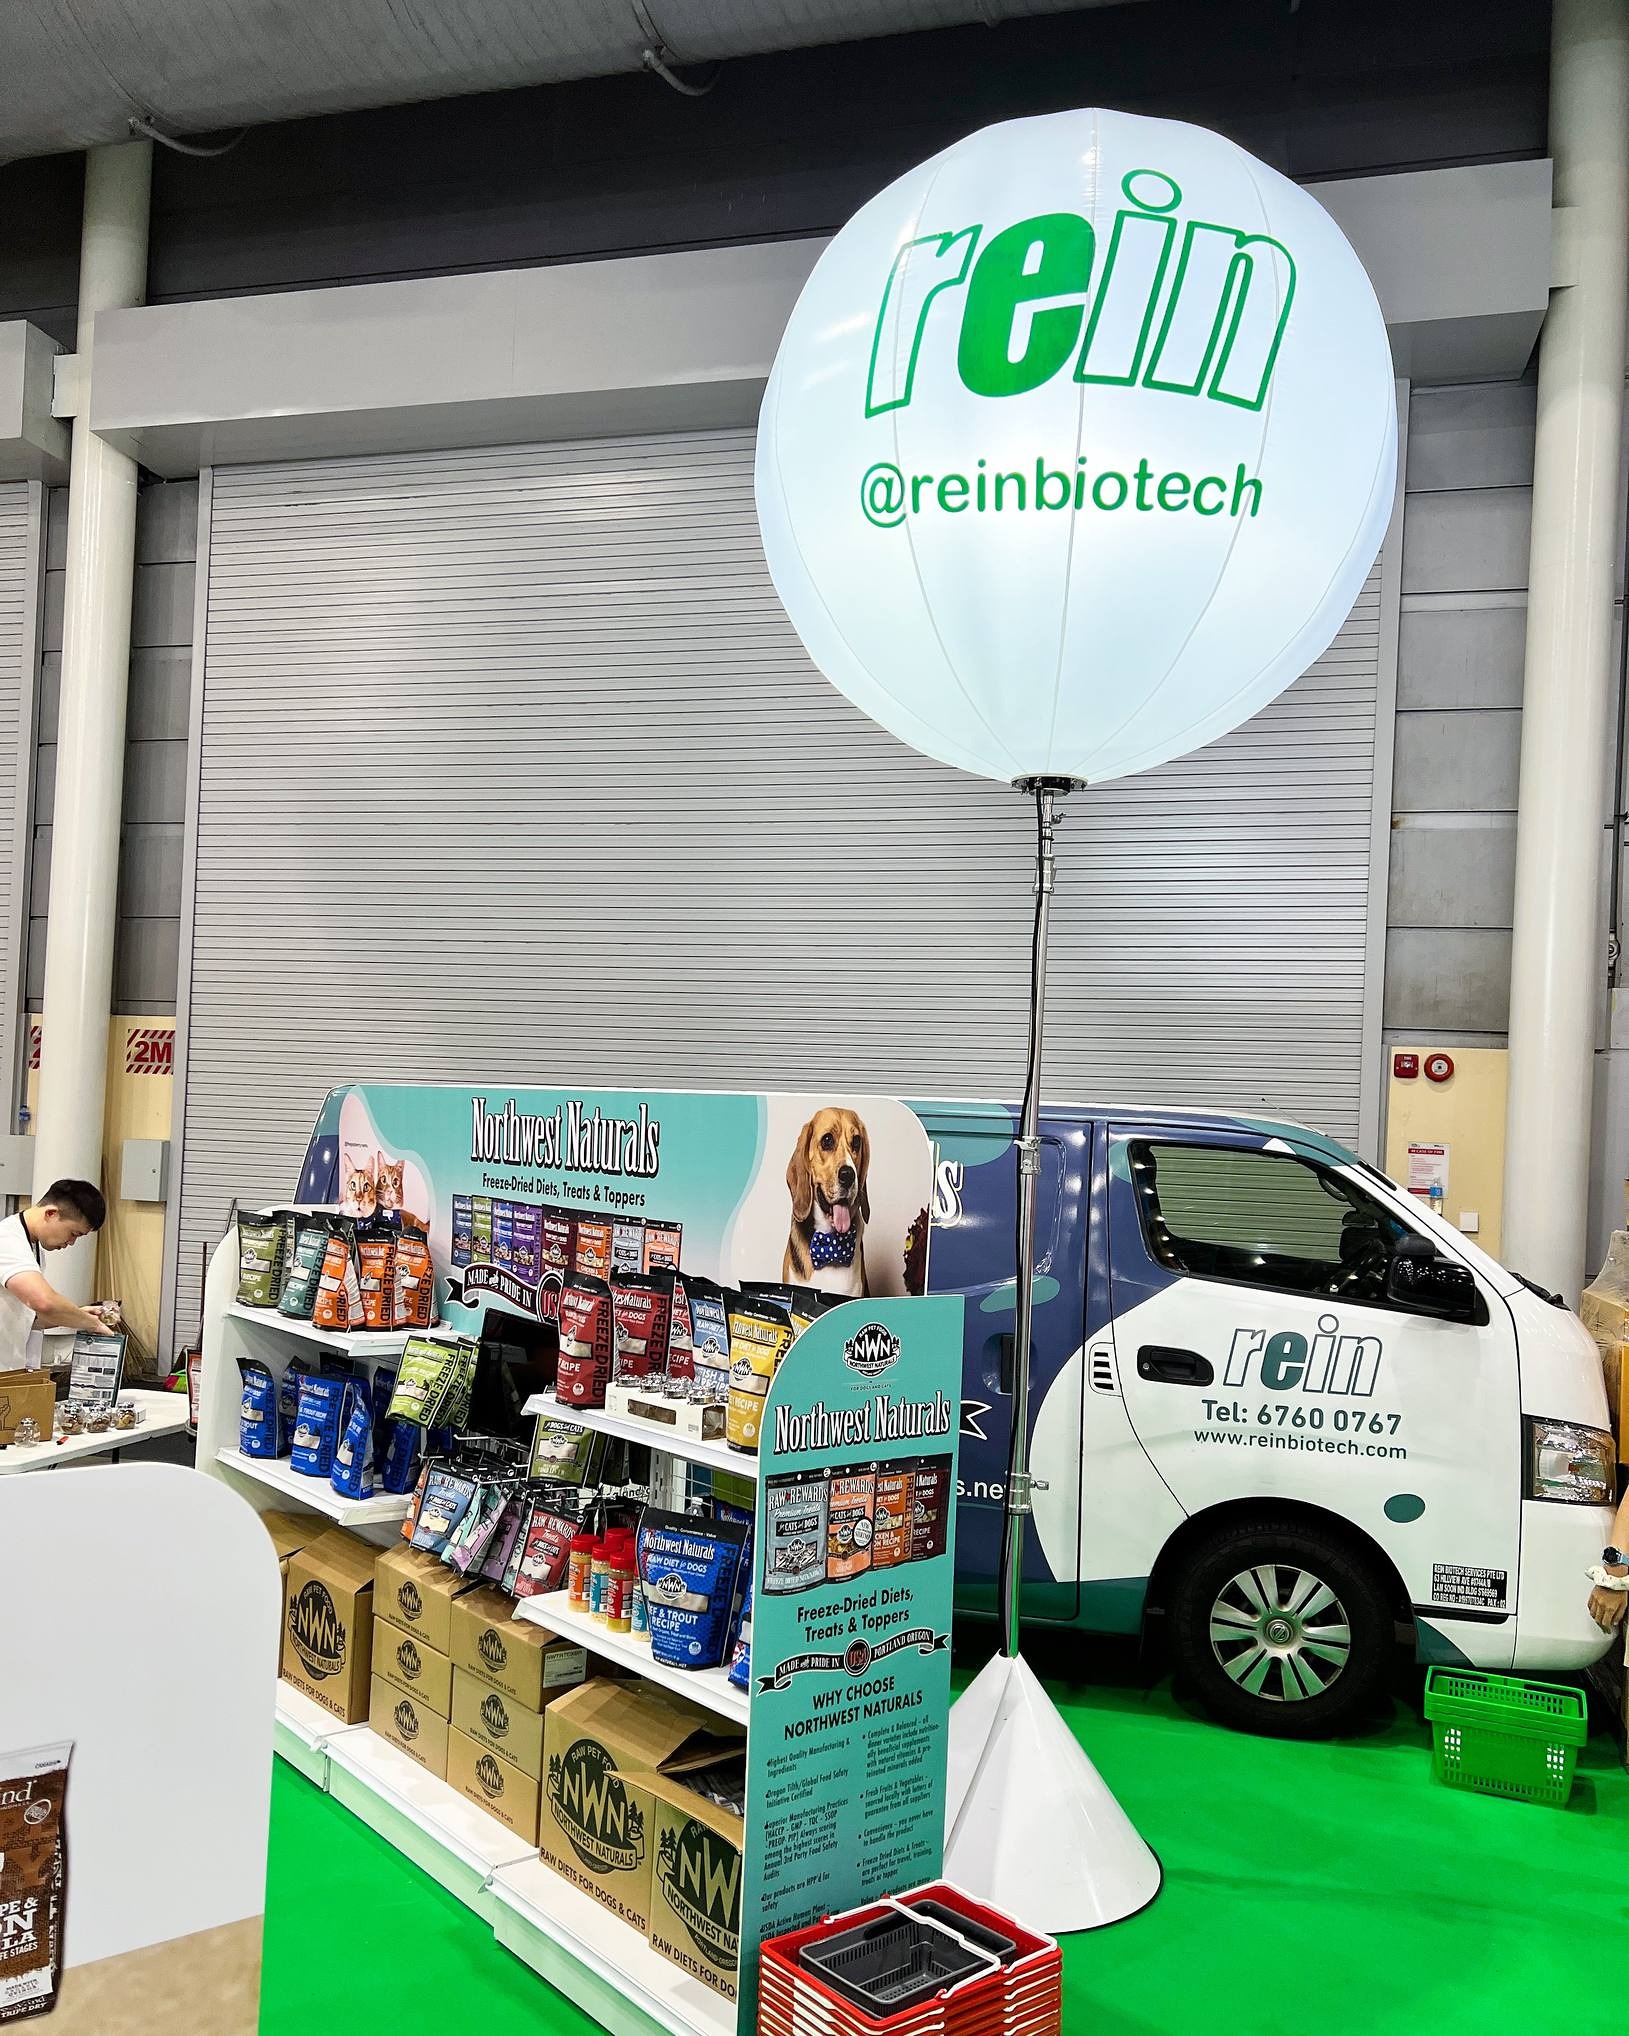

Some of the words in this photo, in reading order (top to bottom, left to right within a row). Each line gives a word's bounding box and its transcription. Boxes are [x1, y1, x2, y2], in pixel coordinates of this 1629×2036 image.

[865, 168, 1297, 419] rein
[861, 455, 1263, 528] @reinbiotech
[134, 1041, 172, 1063] 2M
[471, 1097, 562, 1168] Northwest
[565, 1101, 660, 1178] Naturals
[482, 1173, 533, 1193] Freeze-Dried
[536, 1178, 560, 1198] Diets,
[563, 1182, 590, 1200] Treats
[594, 1185, 601, 1201] &
[604, 1186, 645, 1209] Toppers
[467, 1269, 489, 1286] MADE
[500, 1275, 521, 1302] PRIDE
[522, 1290, 532, 1307] IN
[595, 1301, 609, 1350] FREEZE
[854, 1333, 891, 1361] NWN
[1223, 1313, 1383, 1397] rein
[434, 1353, 455, 1390] FREEZE
[592, 1351, 608, 1398] DRIED
[419, 1390, 440, 1421] DRIED
[1202, 1399, 1248, 1423] Tel:
[1257, 1404, 1325, 1430] 6760
[1333, 1409, 1402, 1435] 0767
[774, 1401, 871, 1455] Northwest
[874, 1390, 950, 1441] Naturals
[1194, 1430, 1408, 1460] www.reinbiotech.com
[769, 1490, 786, 1511] RAW
[790, 1486, 828, 1506] REWARDS
[839, 1480, 874, 1494] REWARDS
[955, 1478, 1007, 1499] s.ne
[532, 1515, 547, 1527] RAW
[548, 1517, 576, 1542] REWARDS
[785, 1520, 798, 1531] CATS
[804, 1517, 818, 1529] DOGS
[835, 1510, 847, 1519] CATS
[852, 1507, 864, 1517] DOGS
[644, 1532, 684, 1555] Northwest
[684, 1539, 715, 1560] Naturals
[647, 1554, 662, 1565] RAW
[663, 1557, 679, 1568] DIET
[687, 1563, 707, 1574] DOGS
[662, 1579, 682, 1592] NWN
[659, 1608, 665, 1618] &
[667, 1609, 698, 1626] TROUT
[797, 1590, 877, 1623] Freeze-Dried
[881, 1587, 914, 1604] Diets,
[298, 1598, 335, 1654] NWN
[652, 1616, 680, 1632] RECIPE
[805, 1622, 844, 1642] Treats
[848, 1616, 857, 1633] &
[862, 1609, 910, 1631] Toppers
[291, 1633, 316, 1665] NORTHWEST
[317, 1657, 341, 1672] NATURALS
[849, 1647, 867, 1667] USA
[873, 1635, 906, 1658] PORTLAND
[906, 1631, 931, 1643] OREGON
[779, 1658, 800, 1676] MADE
[811, 1657, 830, 1668] PRIDE
[831, 1656, 840, 1668] IN
[293, 1675, 306, 1690] DIETS
[305, 1684, 315, 1698] FOR
[315, 1689, 329, 1706] DOGS
[333, 1703, 346, 1718] CATS
[812, 1689, 842, 1710] WHY
[846, 1676, 895, 1699] CHOOSE
[784, 1706, 860, 1740] NORTHWEST
[863, 1690, 923, 1719] NATURALS
[571, 1745, 586, 1763] RAW
[586, 1745, 601, 1759] PET
[563, 1761, 626, 1843] NWN
[554, 1803, 594, 1851] NORTHWEST
[595, 1840, 634, 1867] NATURALS
[24, 1897, 39, 1909] &
[540, 1847, 557, 1867] RAW
[558, 1859, 577, 1882] DIETS
[579, 1874, 594, 1893] FOR
[595, 1886, 617, 1910] DOGS
[618, 1903, 625, 1915] &
[626, 1908, 646, 1930] CATS
[667, 1883, 721, 1943] NORTHWEST
[10, 1941, 38, 1958] STAGES
[652, 1933, 671, 1954] RAW
[673, 1948, 698, 1974] DIETS
[700, 1965, 718, 1987] FOR
[720, 1978, 737, 1999] DO
